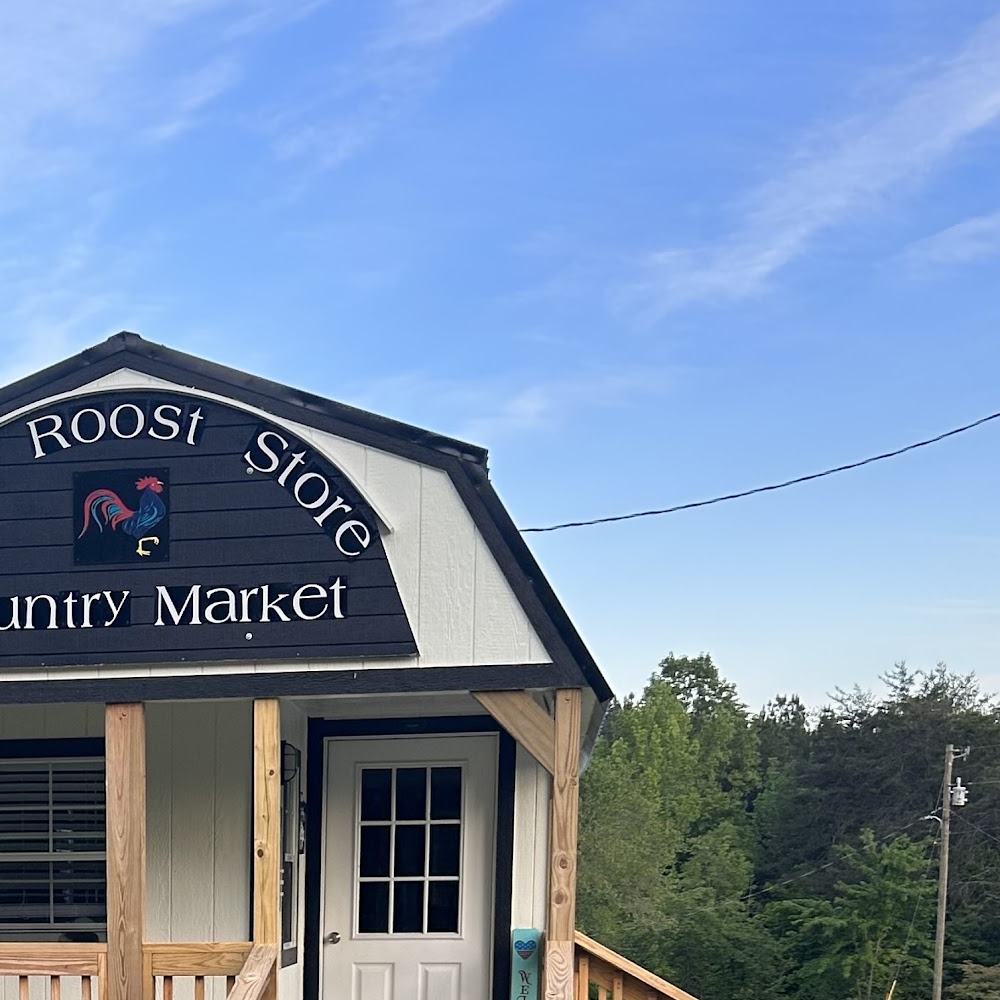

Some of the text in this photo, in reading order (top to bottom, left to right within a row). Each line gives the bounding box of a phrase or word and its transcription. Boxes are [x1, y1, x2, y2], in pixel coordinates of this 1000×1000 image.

[27, 401, 204, 459] Roost
[243, 431, 371, 558] Store
[154, 576, 347, 626] Market
